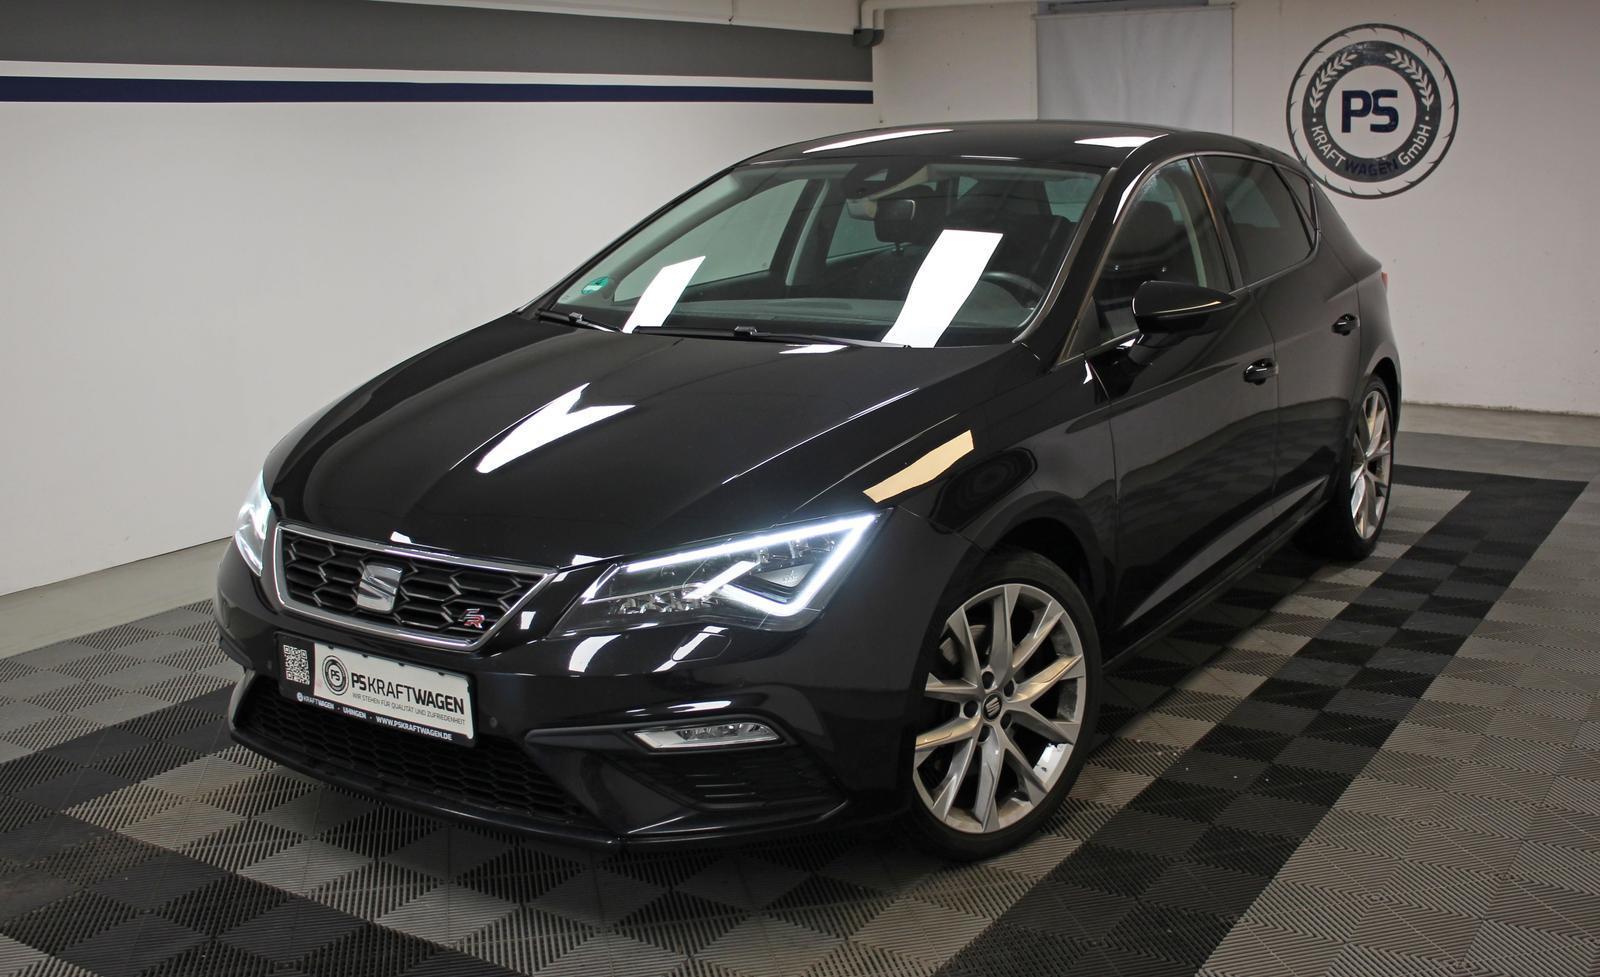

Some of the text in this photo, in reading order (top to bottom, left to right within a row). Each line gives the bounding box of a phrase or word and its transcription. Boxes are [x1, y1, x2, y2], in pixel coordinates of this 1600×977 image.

[1341, 89, 1399, 133] PS
[1398, 124, 1432, 166] GmbH
[330, 669, 341, 681] PS
[362, 695, 380, 705] STEHEN
